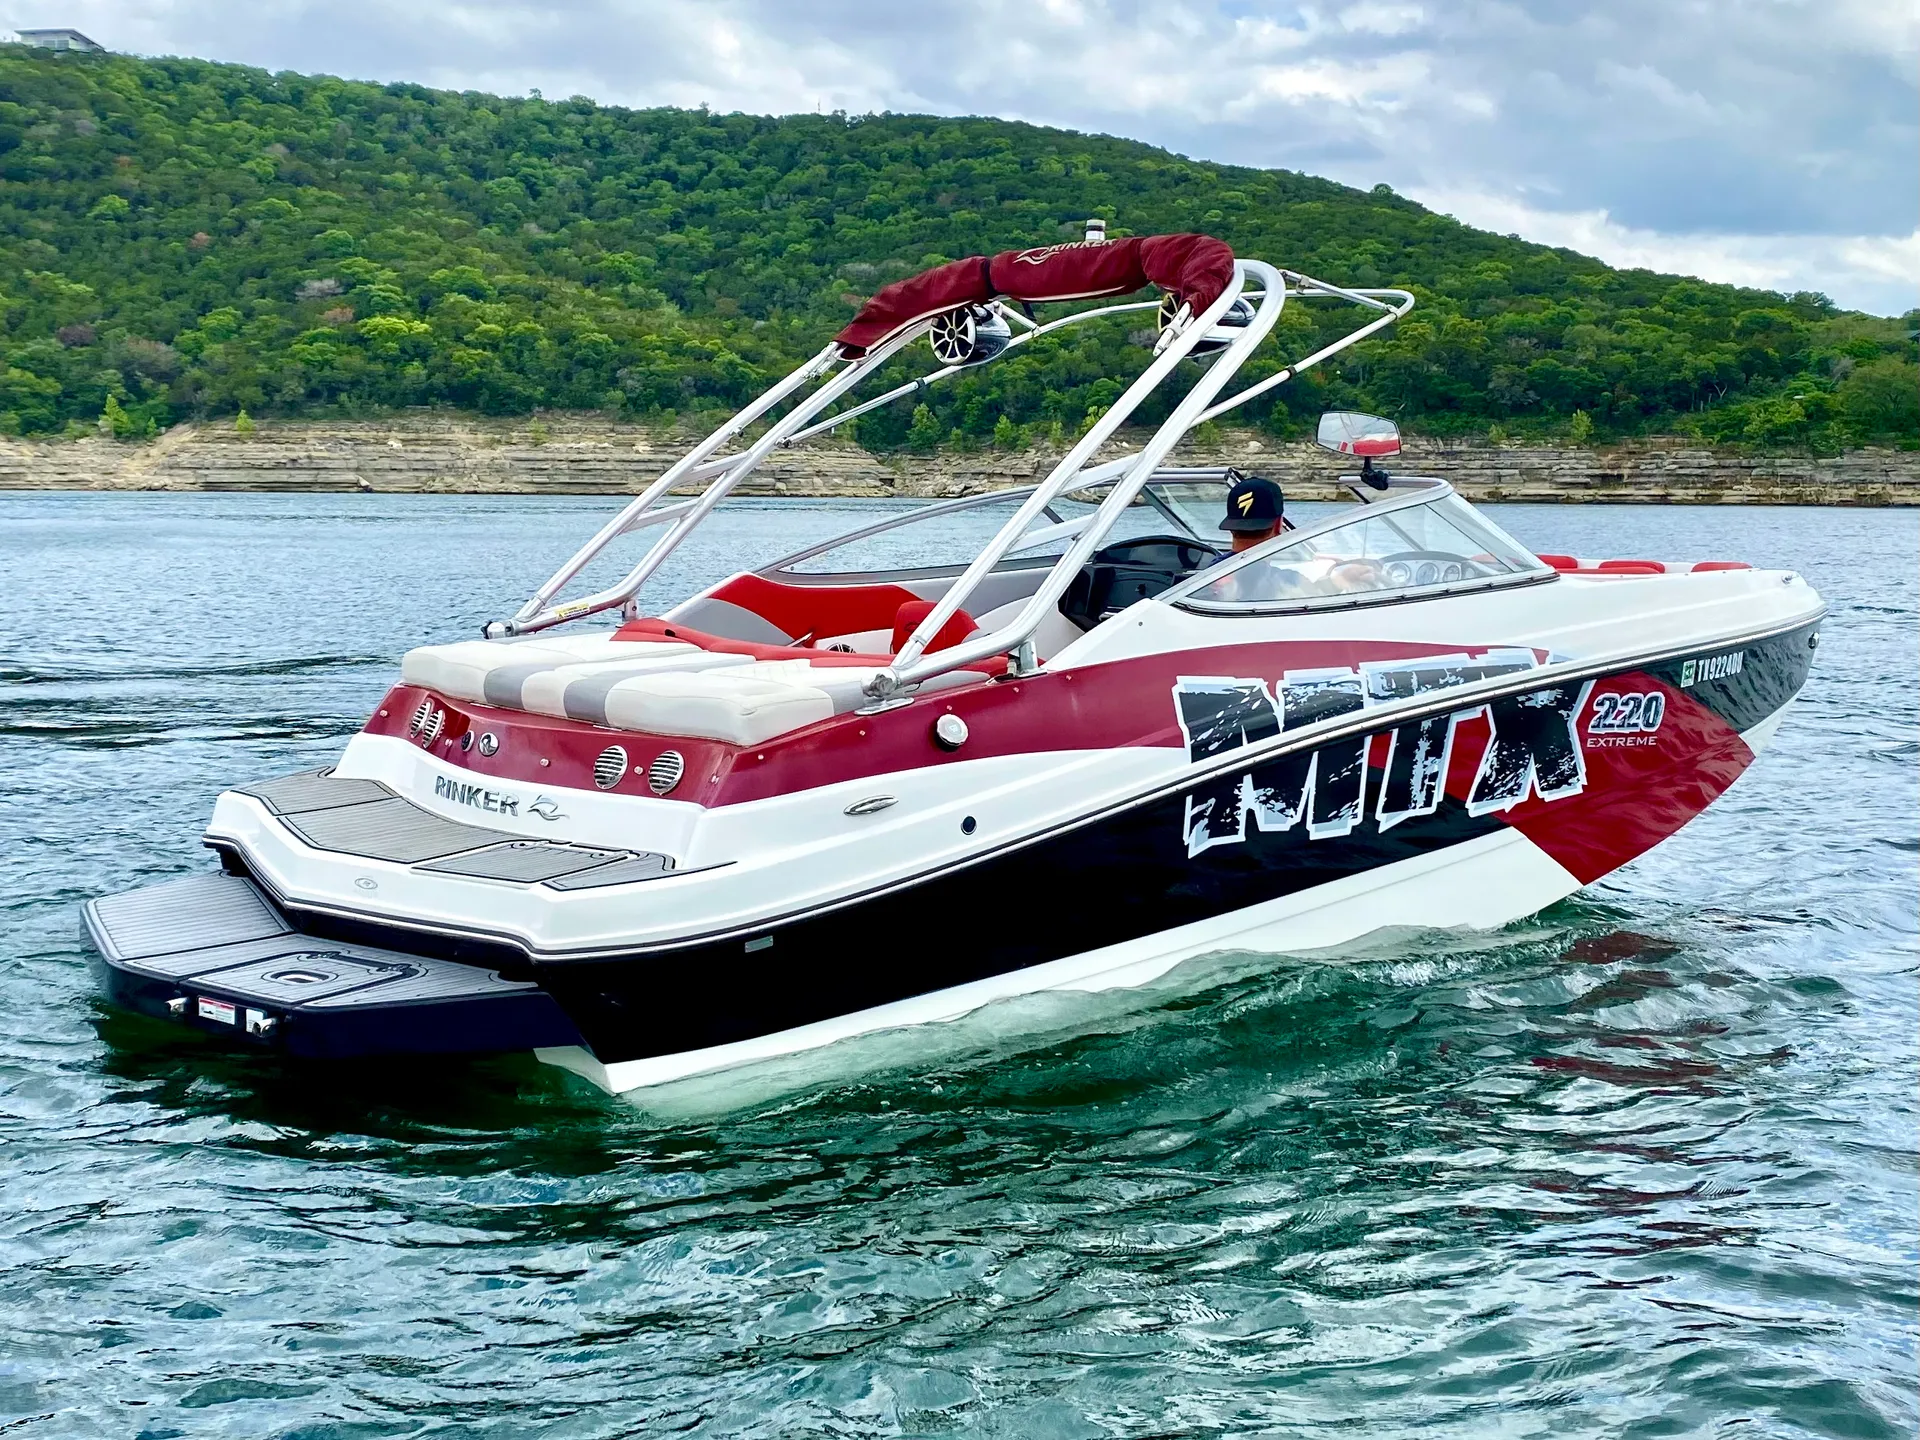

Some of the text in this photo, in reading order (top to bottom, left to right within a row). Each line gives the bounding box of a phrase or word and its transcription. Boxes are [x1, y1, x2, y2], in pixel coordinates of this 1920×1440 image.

[1587, 691, 1666, 734] 220
[1586, 736, 1658, 748] EXTREME
[434, 775, 520, 817] RINKER
